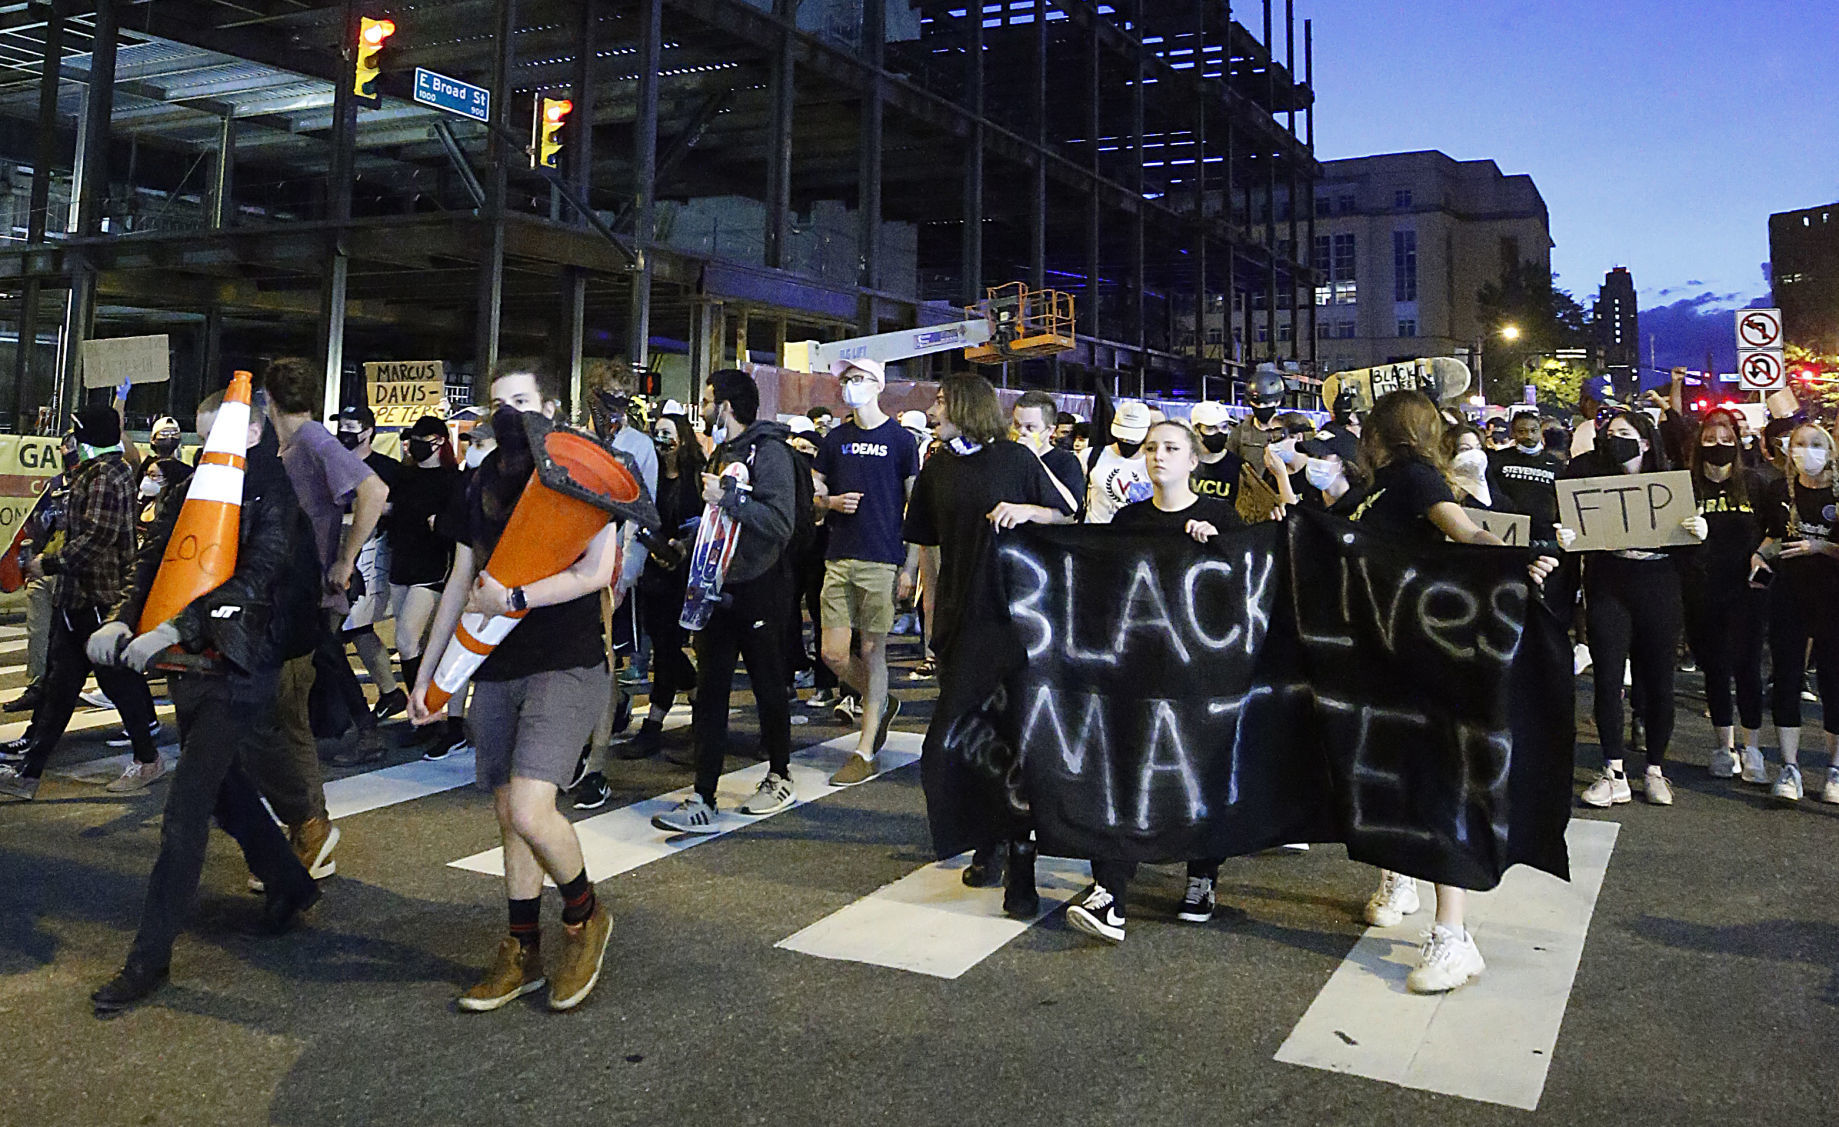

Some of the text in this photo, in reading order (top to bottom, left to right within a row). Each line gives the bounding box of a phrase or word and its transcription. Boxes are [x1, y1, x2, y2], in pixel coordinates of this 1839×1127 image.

[419, 90, 436, 101] 1000
[420, 73, 486, 106] E Broad St
[471, 107, 485, 117] 900
[377, 364, 435, 382] MARCUS
[1373, 367, 1416, 383] BLACK
[376, 385, 439, 403] DAVIS-
[1502, 465, 1555, 480] STEVENSON
[1505, 472, 1550, 484] FOOTBALL
[1192, 479, 1231, 497] VCU
[1572, 483, 1673, 537] FTP
[1000, 547, 1274, 664] BLACK
